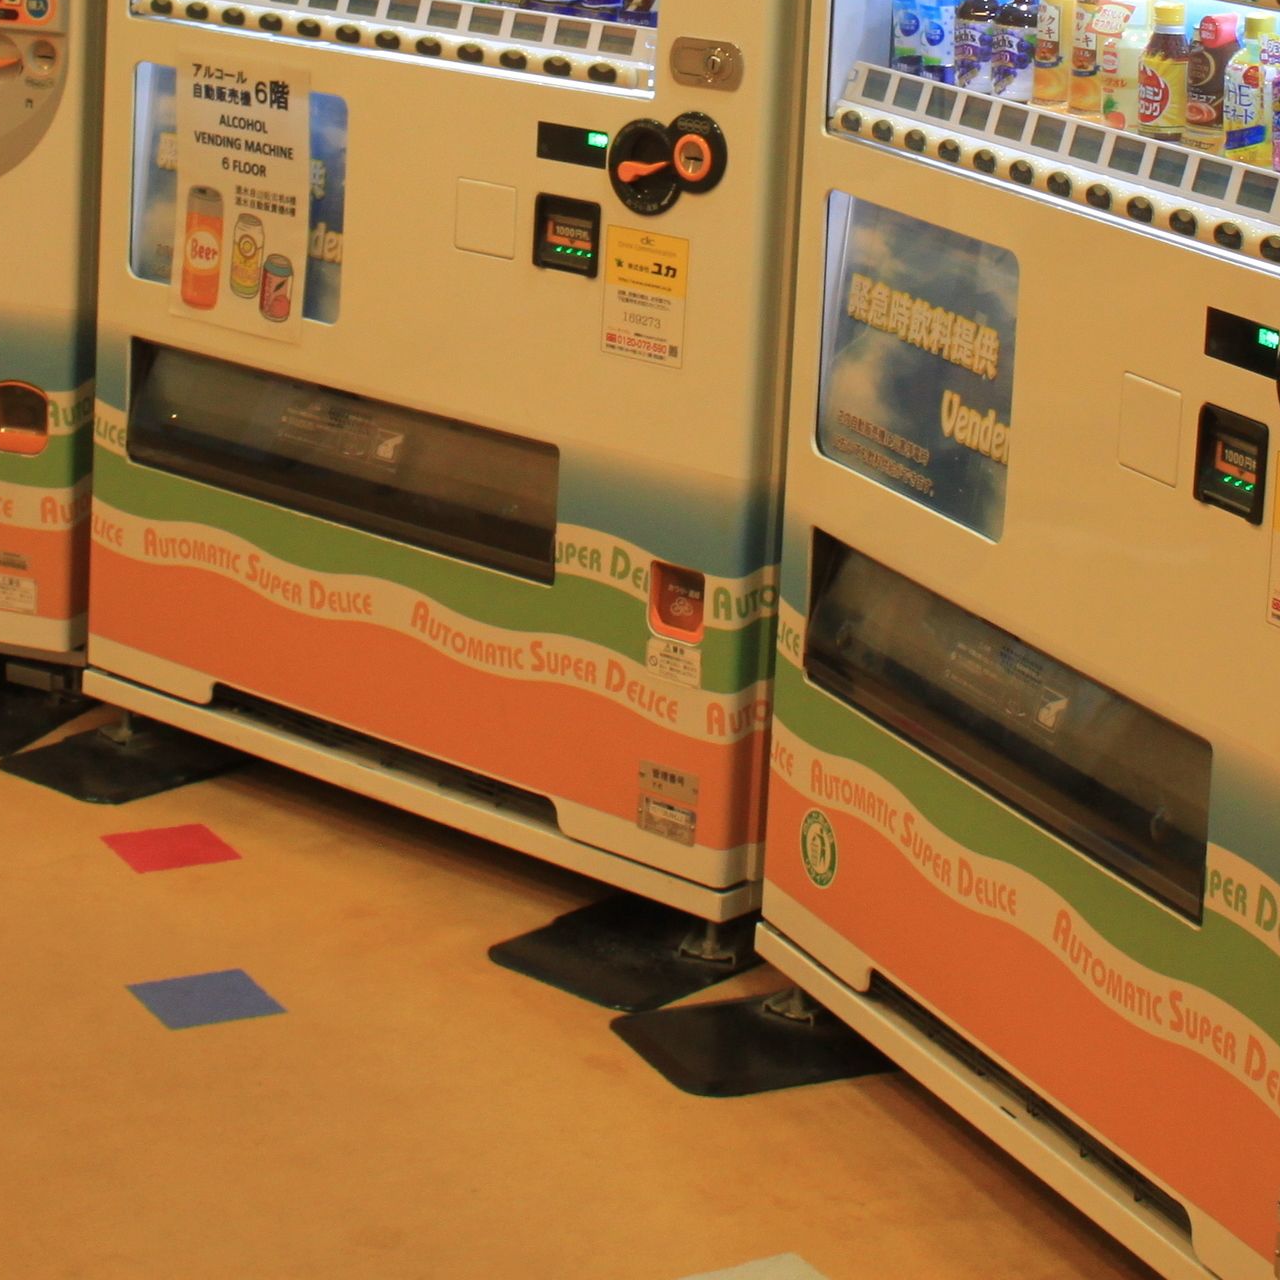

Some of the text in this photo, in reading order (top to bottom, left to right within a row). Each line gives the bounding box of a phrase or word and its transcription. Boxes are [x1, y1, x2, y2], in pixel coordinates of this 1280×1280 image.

[192, 63, 247, 84] アルコール
[192, 80, 289, 111] 自動販売機 6階
[1227, 84, 1252, 107] HE
[219, 114, 268, 134] ALCOHOL
[194, 130, 293, 161] VENDING MACHINE
[221, 157, 267, 178] 6 FLOOR
[190, 238, 218, 261] Beer
[847, 272, 1001, 381] 緊急時飲料提供
[143, 527, 373, 615] AUTOMATIC SUPER DELICE
[411, 600, 678, 722] AUTOMATIC SUPER DELICE
[810, 758, 1017, 916] AUTOMATIC SUPER DELICE
[1052, 908, 1163, 1026] AUTOMATIC
[1169, 990, 1236, 1064] SUPER
